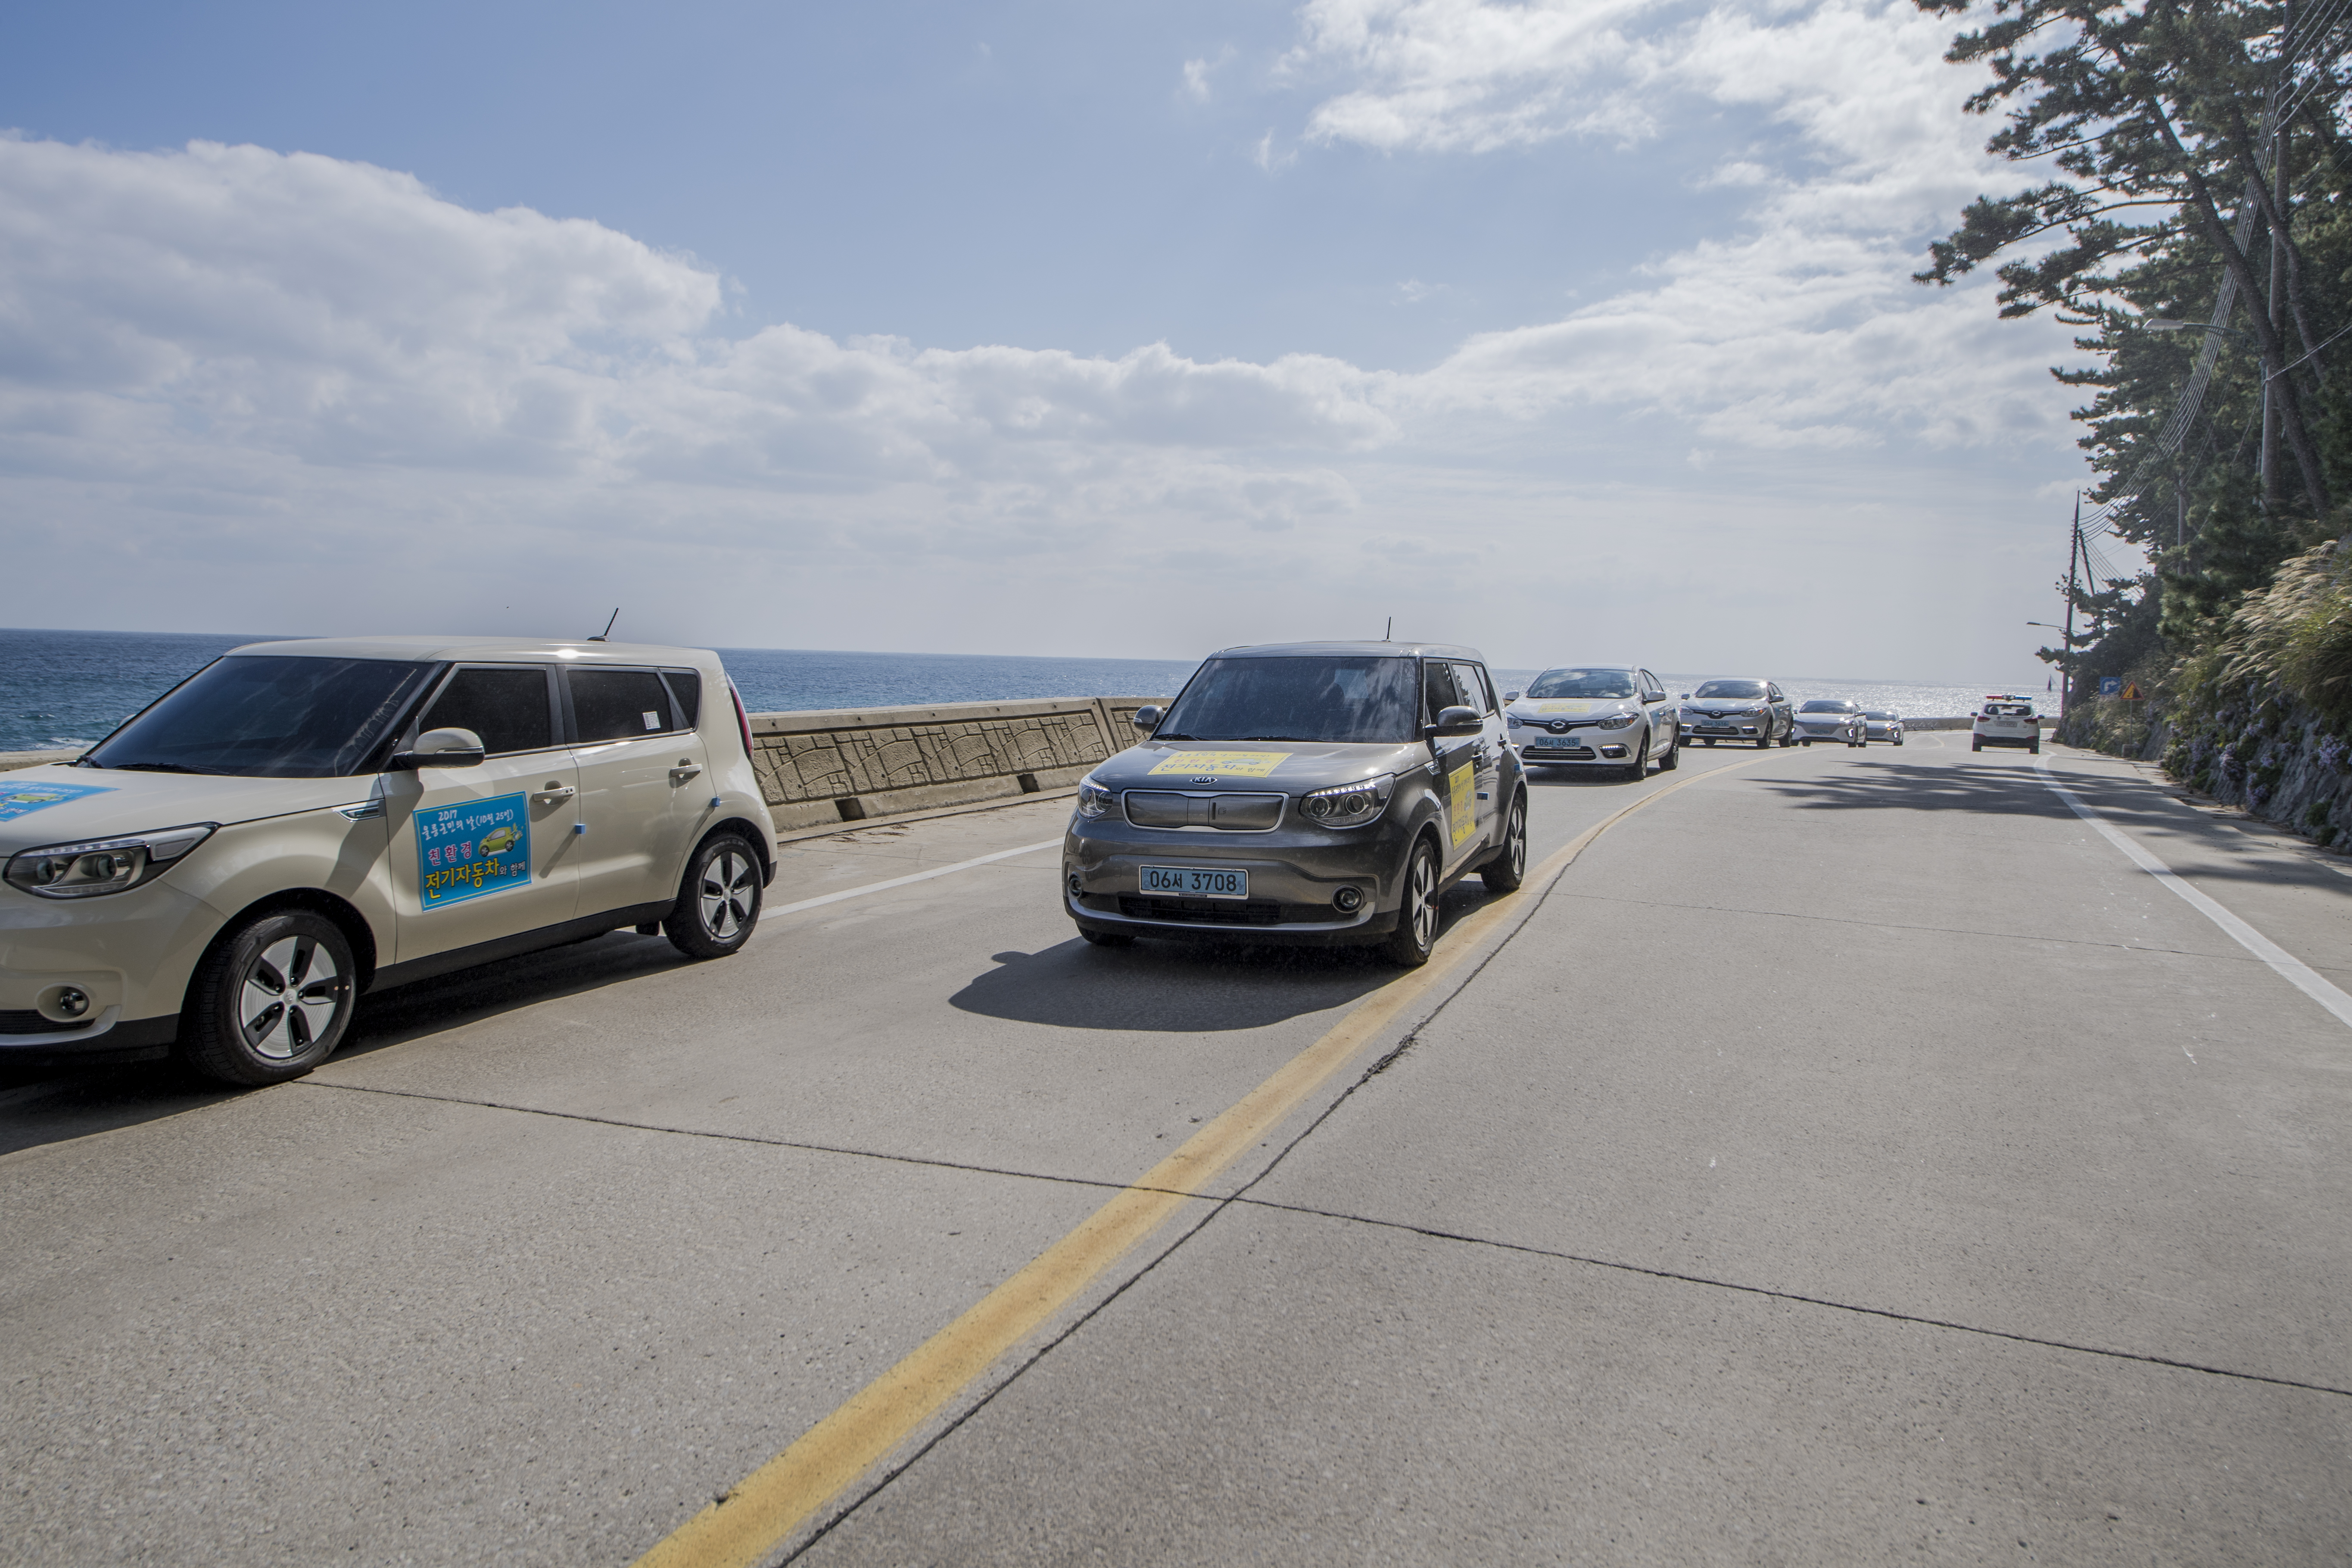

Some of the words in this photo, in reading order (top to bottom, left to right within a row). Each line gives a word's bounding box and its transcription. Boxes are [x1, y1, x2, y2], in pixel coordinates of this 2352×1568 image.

[421, 820, 464, 841] 울릉군민의
[495, 809, 514, 822] 25일)
[438, 810, 458, 821] 2017
[510, 861, 526, 877] 함께
[1150, 870, 1183, 888] 06서
[1191, 873, 1237, 892] 3708
